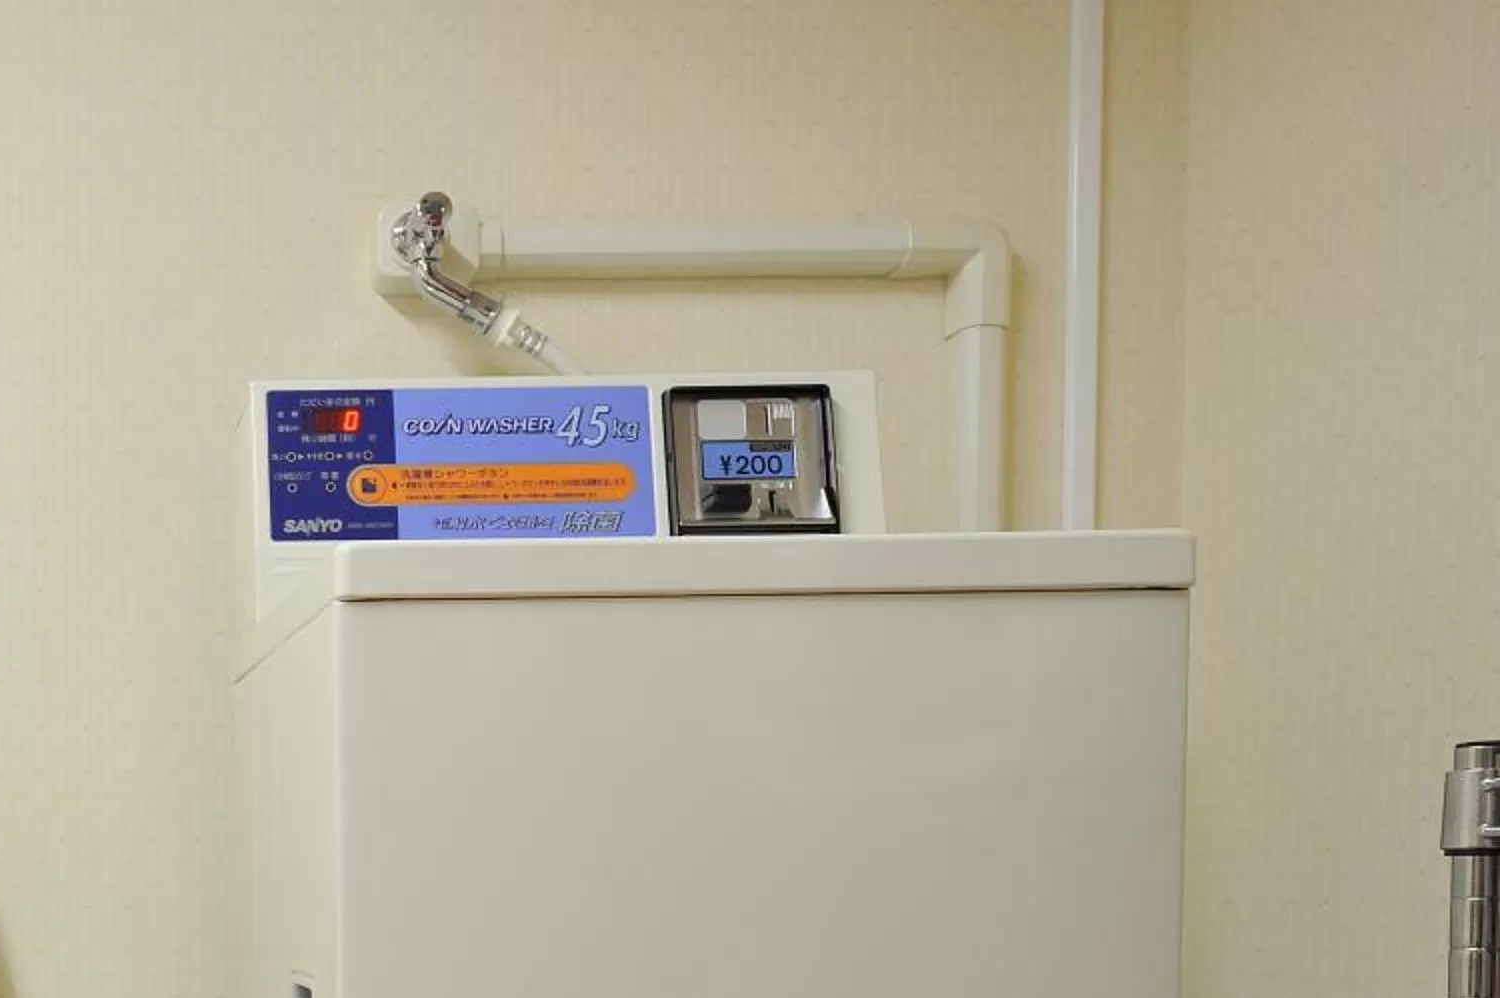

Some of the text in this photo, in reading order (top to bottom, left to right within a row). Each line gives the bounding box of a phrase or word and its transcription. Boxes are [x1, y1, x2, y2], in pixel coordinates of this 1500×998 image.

[344, 410, 360, 432] 0
[403, 413, 462, 435] COIN
[467, 416, 554, 435] WASHER
[720, 455, 783, 476] ¥200
[283, 517, 343, 534] SANYO
